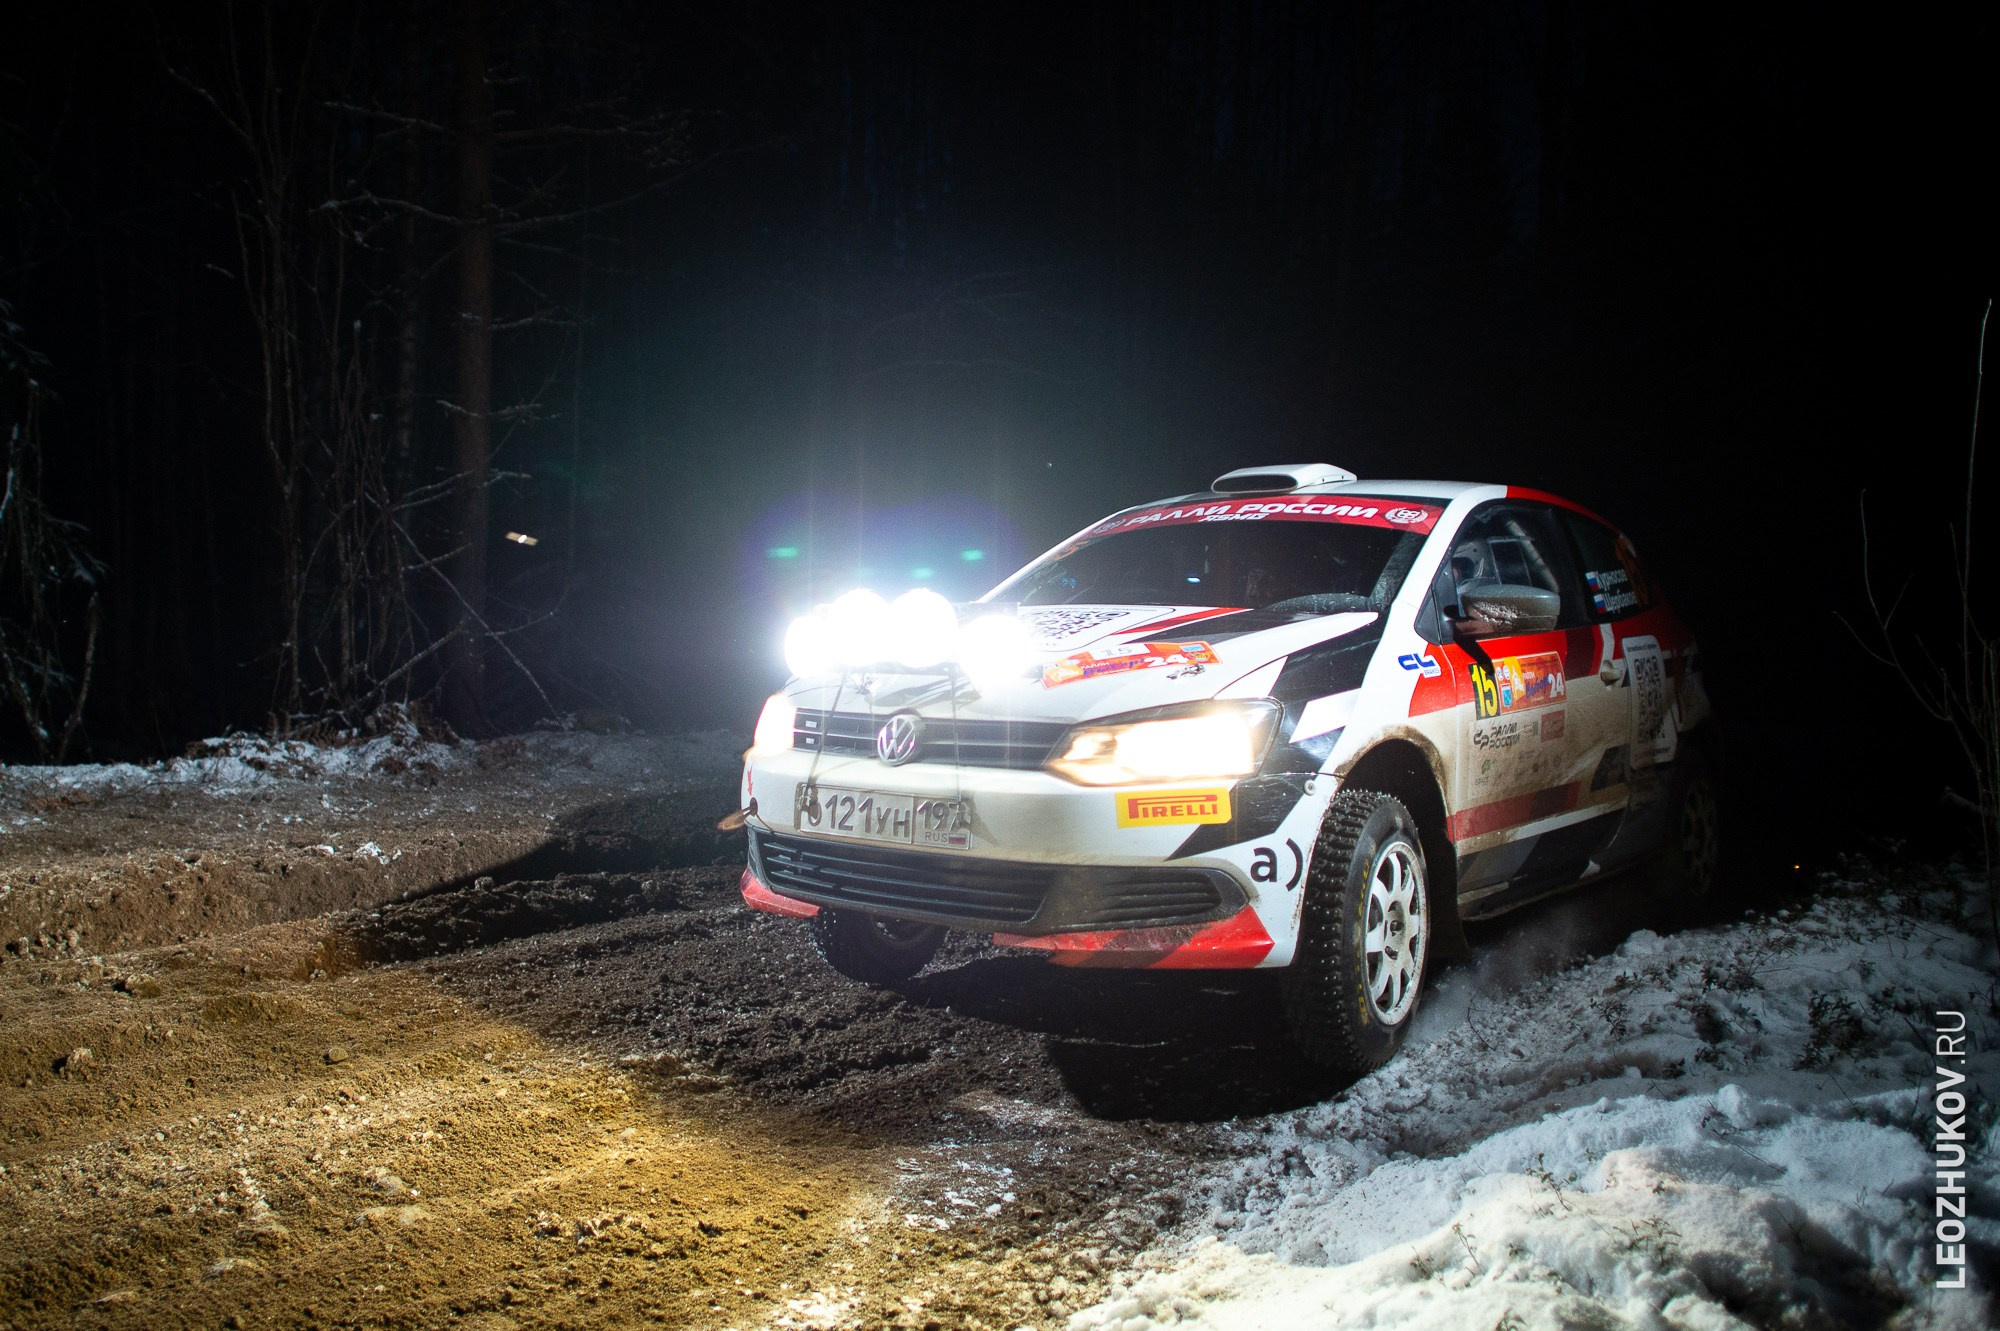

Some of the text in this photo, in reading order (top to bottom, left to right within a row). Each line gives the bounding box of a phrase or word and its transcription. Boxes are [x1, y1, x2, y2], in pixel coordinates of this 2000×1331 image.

[1124, 502, 1379, 526] РАЛЛИ РОССИИ
[1144, 654, 1190, 668] 24
[1471, 664, 1498, 717] 15
[1548, 672, 1565, 699] 24
[1128, 794, 1218, 820] PIRELLI
[925, 831, 948, 843] RUS
